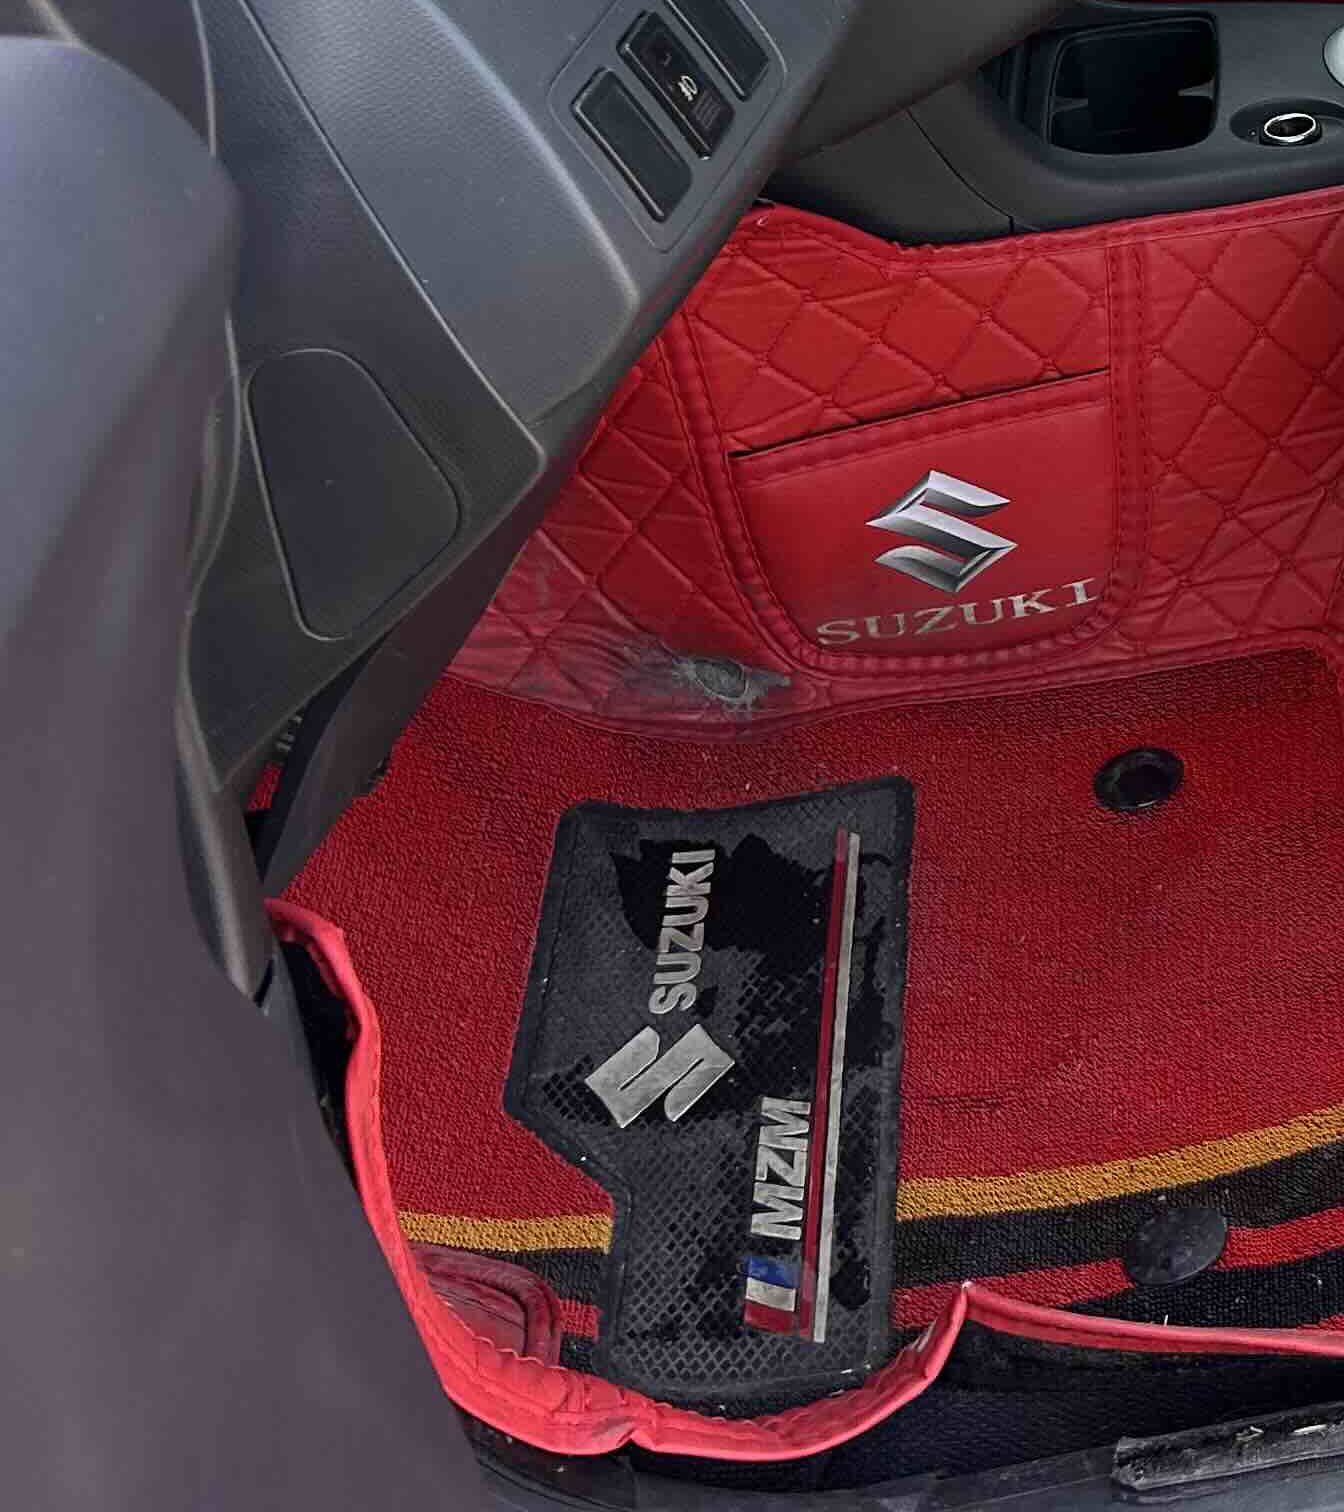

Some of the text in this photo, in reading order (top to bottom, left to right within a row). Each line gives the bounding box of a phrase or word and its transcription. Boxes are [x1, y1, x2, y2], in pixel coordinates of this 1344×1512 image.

[815, 577, 1099, 646] SUZUKI
[648, 847, 716, 1015] SUZUKI
[751, 1096, 811, 1240] MZM
